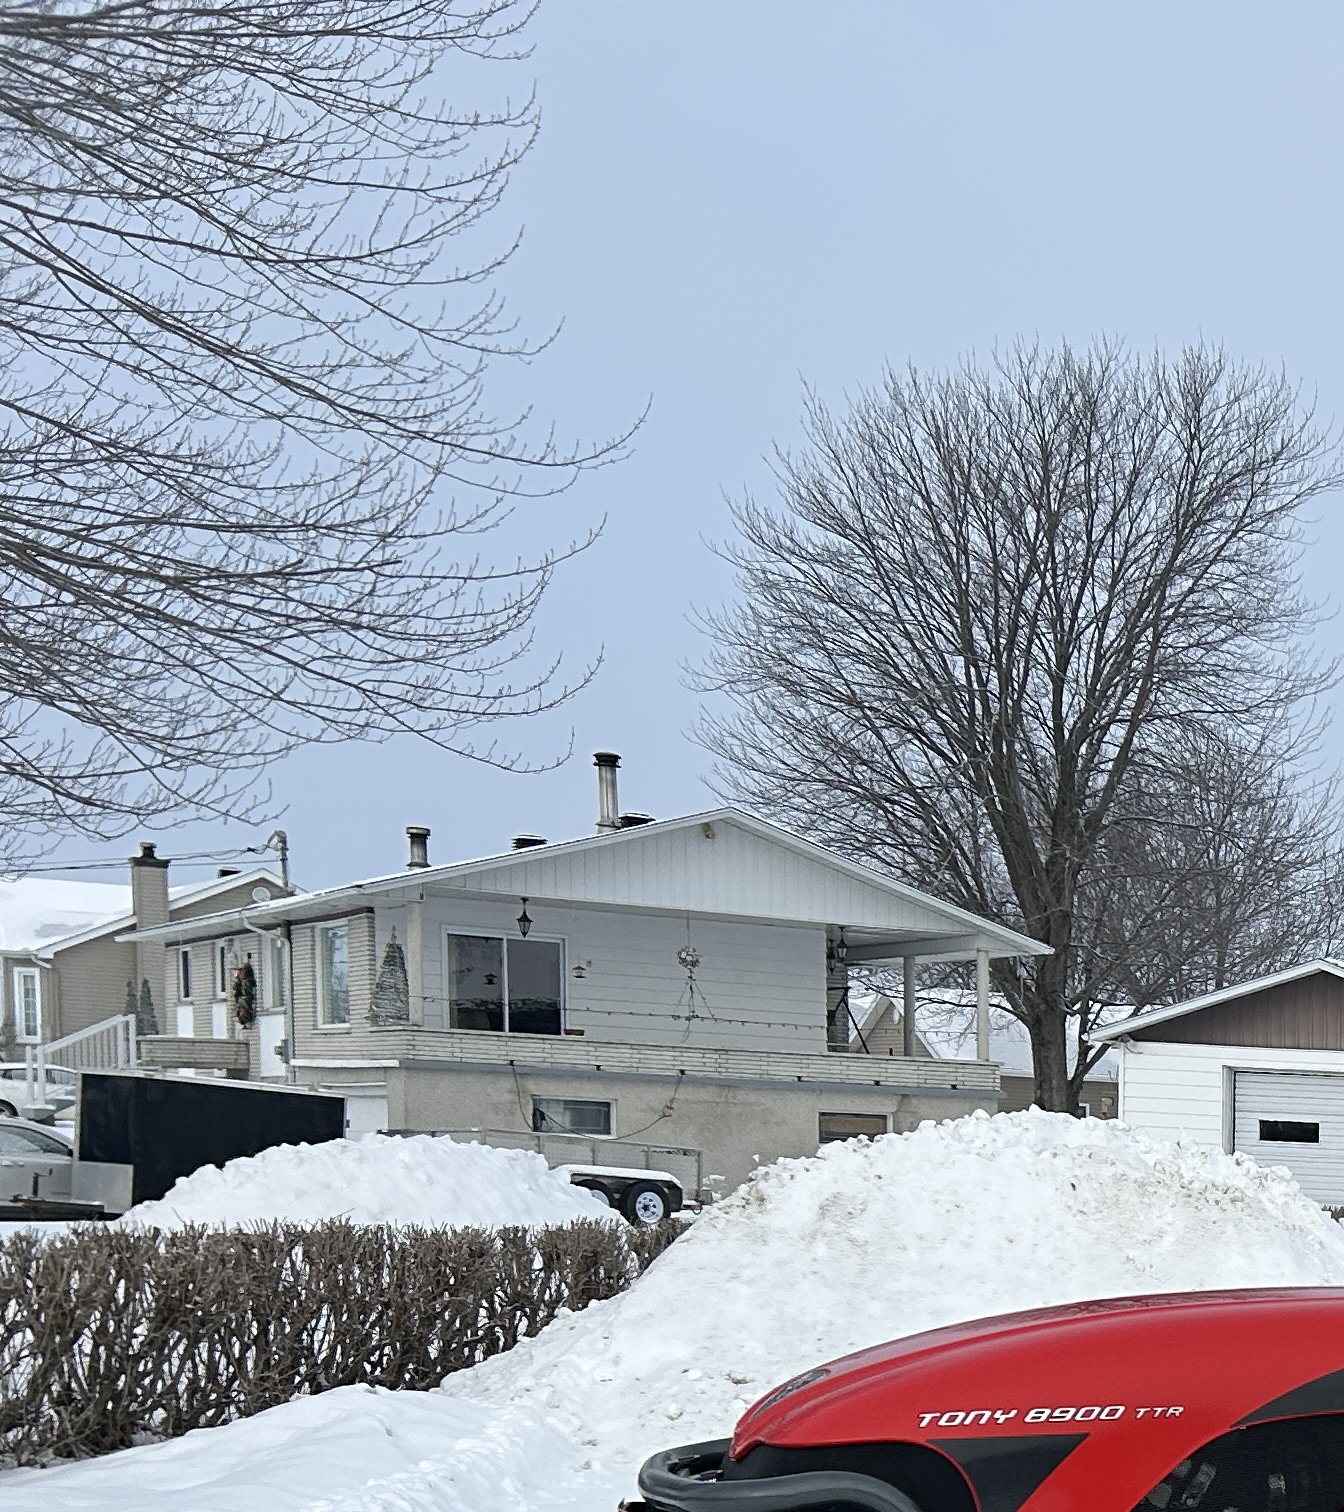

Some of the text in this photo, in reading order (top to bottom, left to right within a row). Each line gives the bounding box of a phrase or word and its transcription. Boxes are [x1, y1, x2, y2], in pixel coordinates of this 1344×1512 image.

[918, 1405, 1185, 1428] TONY 8900 TTR
